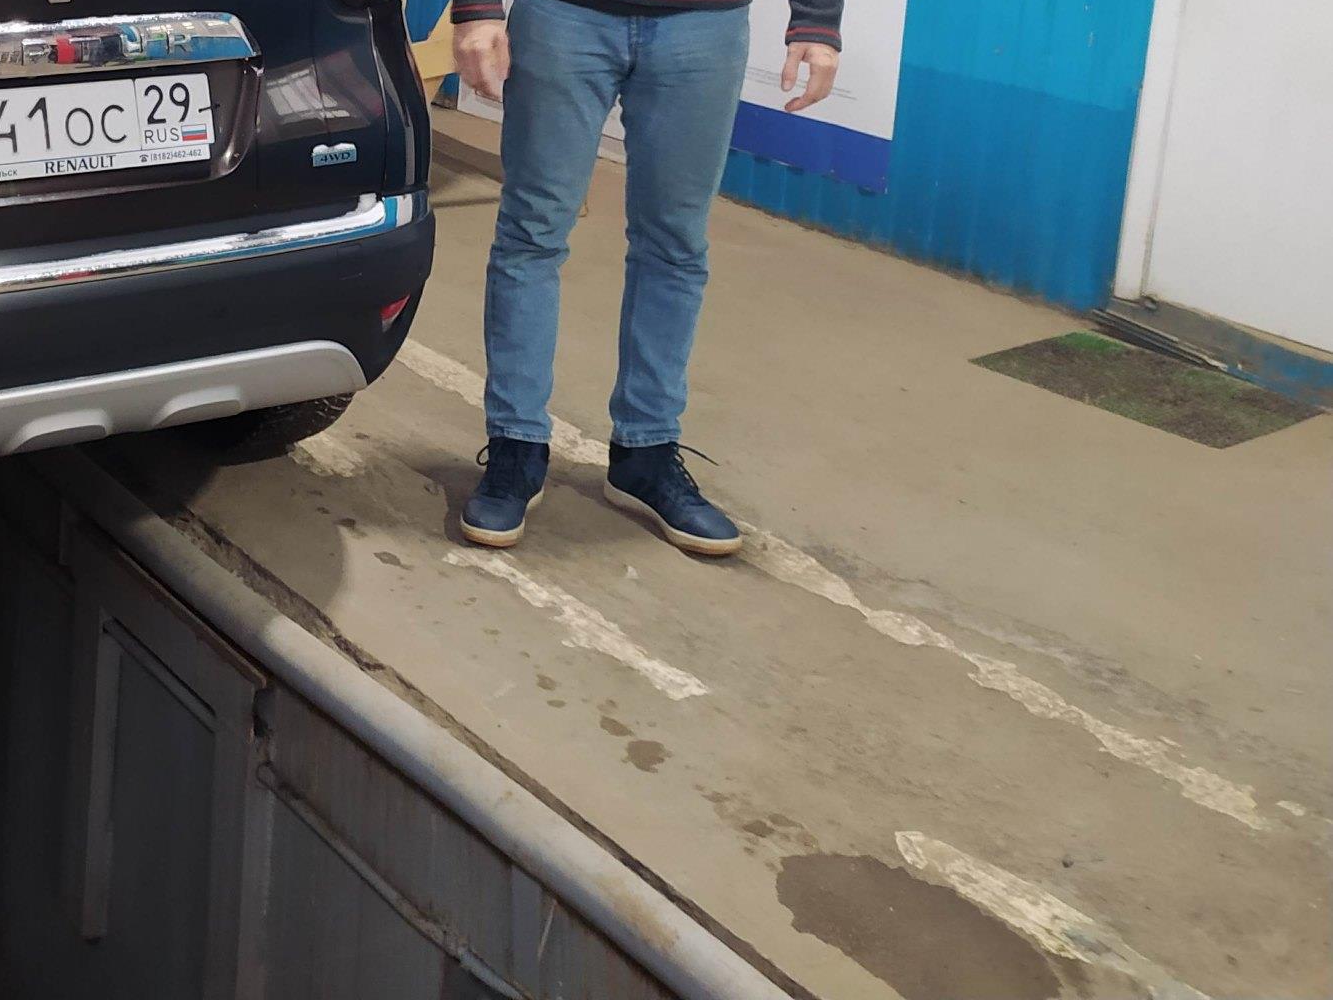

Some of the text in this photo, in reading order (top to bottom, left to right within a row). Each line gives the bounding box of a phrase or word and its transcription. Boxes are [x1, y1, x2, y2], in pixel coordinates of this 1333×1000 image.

[144, 82, 190, 125] 29
[144, 126, 180, 144] RUS
[44, 155, 116, 175] RENAULT
[320, 151, 352, 162] 4WD
